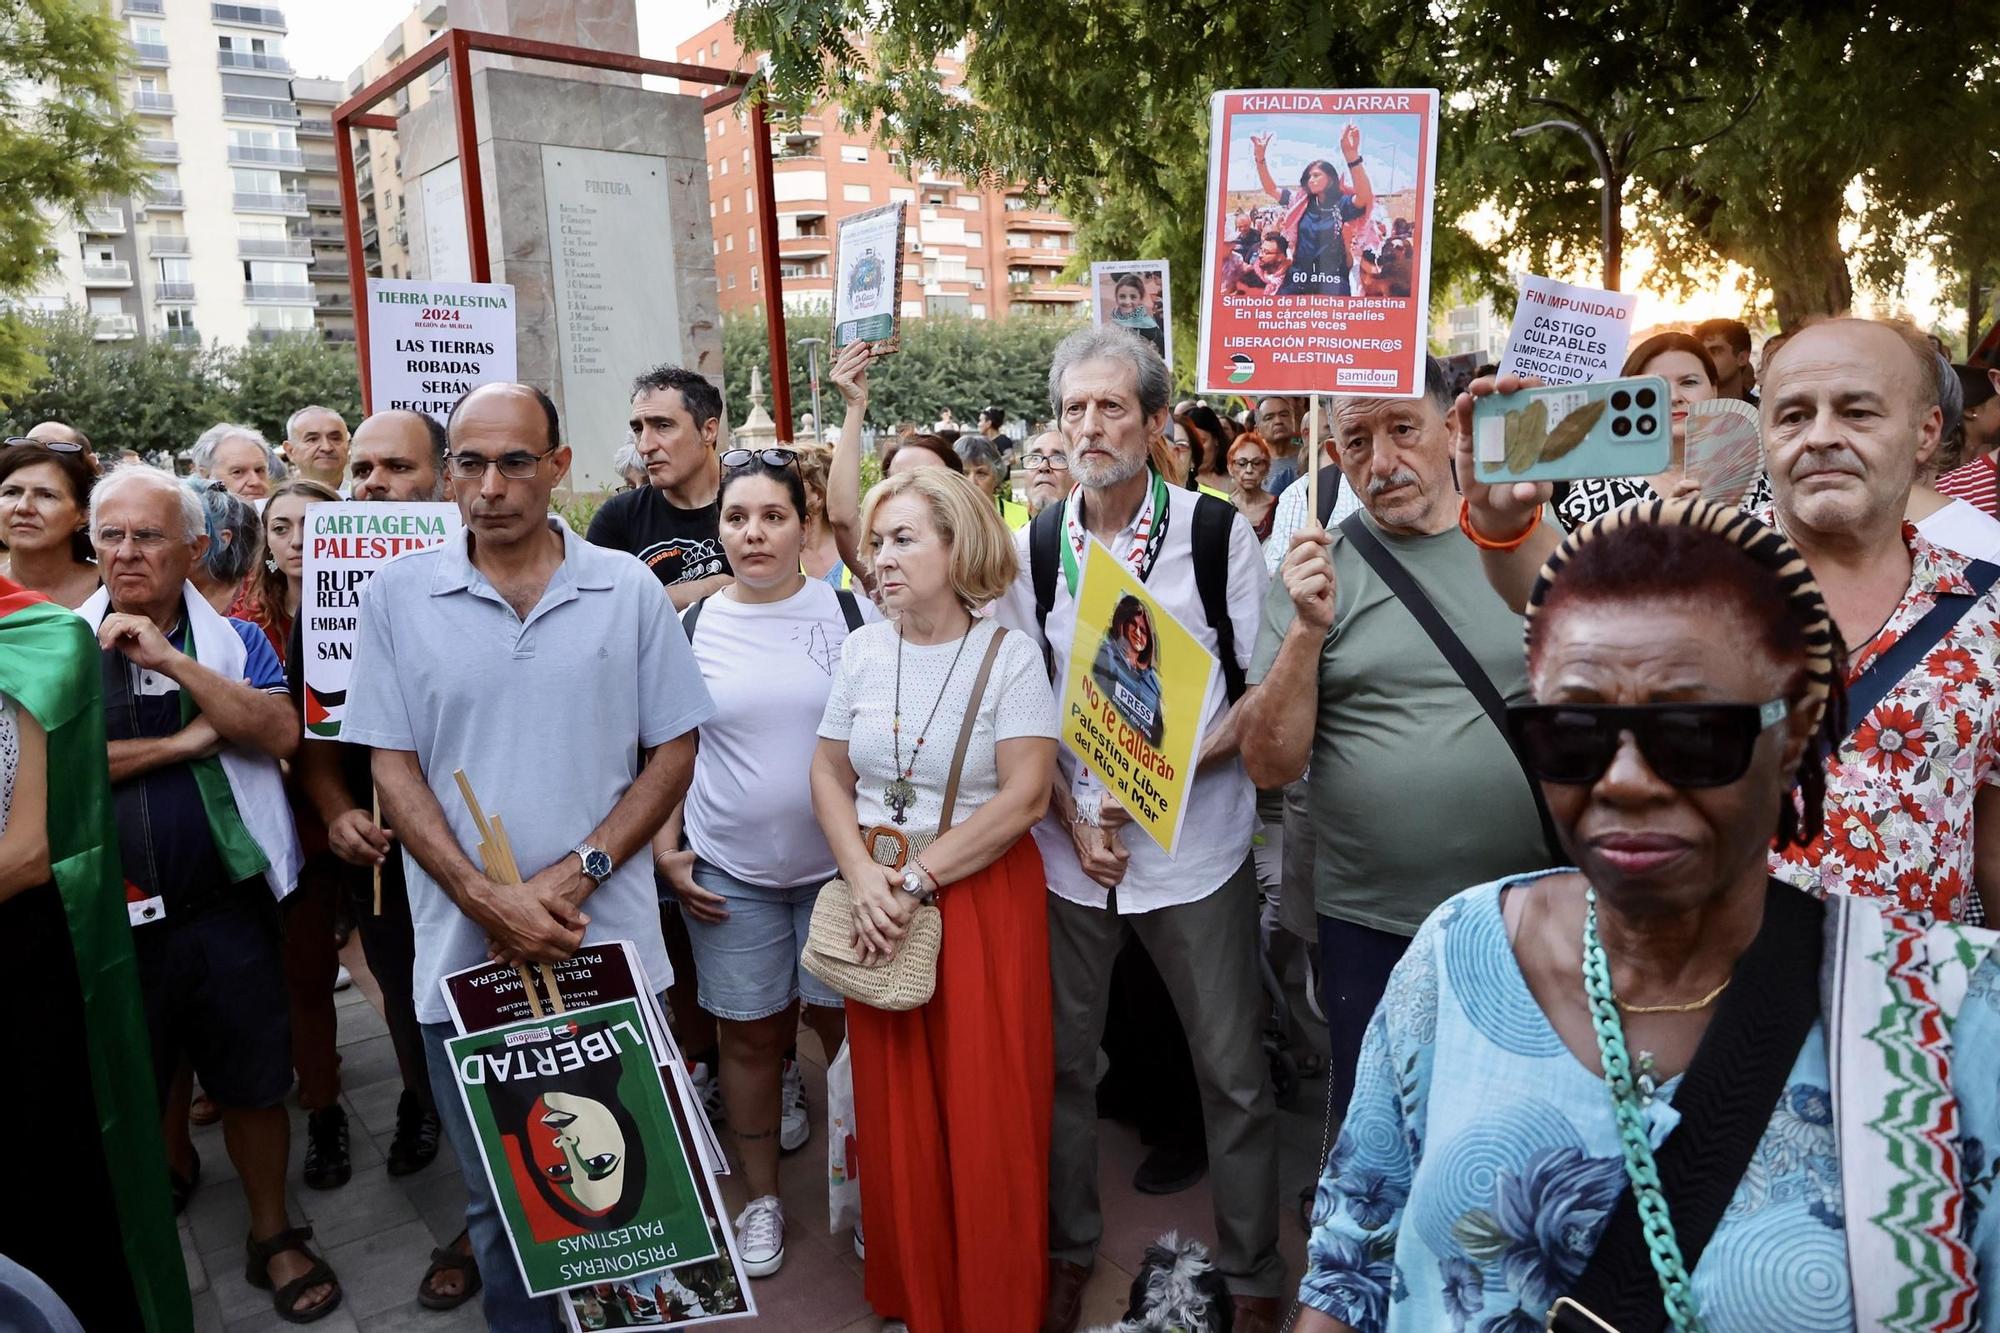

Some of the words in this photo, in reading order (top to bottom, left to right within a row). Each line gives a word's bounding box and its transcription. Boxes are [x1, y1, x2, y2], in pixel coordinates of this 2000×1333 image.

[1242, 96, 1323, 111] KHALIDA
[1333, 96, 1410, 111] JARRAR
[585, 179, 632, 195] PINTURA
[1292, 272, 1307, 284] 60
[1310, 272, 1341, 284] años
[376, 291, 429, 305] TIERRA
[433, 294, 508, 309] PALESTINA
[1222, 296, 1274, 308] Símbolo
[1276, 296, 1292, 307] de
[1296, 296, 1307, 307] la
[1310, 296, 1345, 308] lucha
[1348, 297, 1406, 311] palestina
[1525, 289, 1546, 305] FIN
[1547, 295, 1627, 320] IMPUNIDAD
[422, 308, 461, 321] 2024
[1235, 308, 1251, 319] En
[1254, 308, 1273, 319] las
[1276, 308, 1328, 320] cárceles
[1332, 309, 1385, 321] israelíes
[449, 322, 473, 330] MURCIA
[1258, 319, 1307, 330] muchas
[1310, 321, 1347, 331] veces
[1534, 316, 1596, 338] CASTIGO
[396, 339, 425, 353] LAS
[429, 340, 494, 355] TIERRAS
[1223, 334, 1305, 349] LIBERACIÓN
[1308, 337, 1403, 352] PRISIONER@S
[1523, 329, 1607, 355] CULPABLES
[1272, 352, 1355, 365] PALESTINAS
[1513, 343, 1562, 362] LIMPIEZA
[1564, 351, 1608, 370] ÉTNICA
[406, 360, 481, 375] ROBADAS
[1338, 369, 1397, 382] samidoun
[1515, 357, 1583, 379] GENOCIDIO
[1586, 372, 1595, 383] y
[422, 379, 472, 395] SERÁN
[391, 400, 457, 414] RECUPE
[315, 515, 446, 535] CARTAGENA
[314, 537, 445, 559] PALESTI
[311, 617, 357, 631] EMBAR
[317, 642, 352, 660] SAN
[1120, 689, 1152, 721] PRESS
[1082, 674, 1099, 711] No
[1101, 700, 1117, 733] te
[1118, 721, 1175, 782] callarán
[1071, 702, 1130, 772] Palestina
[1132, 767, 1169, 813] Libre
[1074, 731, 1091, 754] del
[1093, 747, 1115, 779] Río
[1117, 777, 1129, 794] al
[1131, 788, 1160, 823] Mar
[533, 954, 603, 973] PALESTIA
[469, 966, 522, 988] ENCERA
[568, 968, 593, 981] DEL
[495, 980, 524, 995] MAR
[572, 991, 588, 999] LAS
[572, 1000, 591, 1008] TRAS
[507, 1028, 550, 1045] samidoun
[460, 1020, 645, 1086] LIBERTAD
[557, 1219, 665, 1256] PALESTINAS
[560, 1242, 679, 1281] PRISIONERAS
